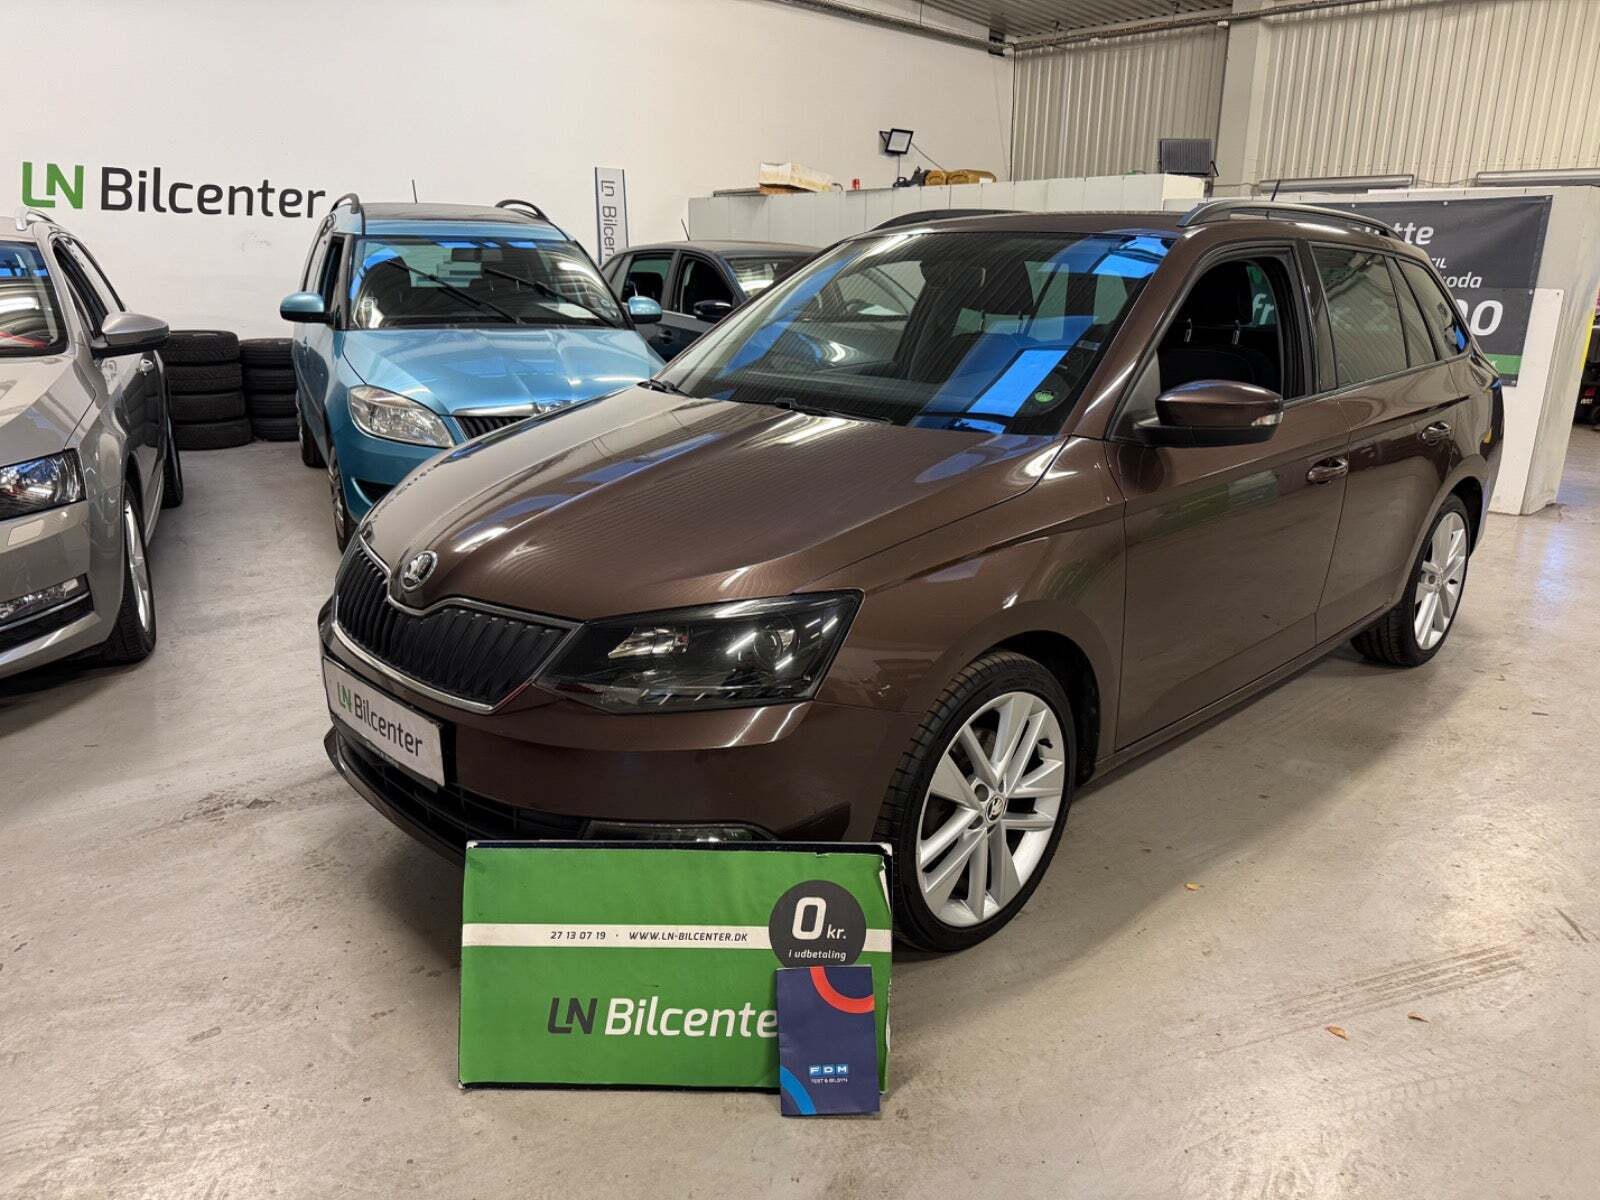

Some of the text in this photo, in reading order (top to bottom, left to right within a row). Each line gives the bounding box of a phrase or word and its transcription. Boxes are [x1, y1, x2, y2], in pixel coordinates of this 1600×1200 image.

[22, 162, 326, 218] LN Bilcenter
[602, 206, 617, 256] Bilcen
[337, 682, 423, 757] LN Bilcenter
[550, 931, 748, 942] 27 13 07 19 WWW.LN-BILCENTER.DK
[792, 897, 847, 940] 0 kr.
[794, 949, 847, 962] udbetaling
[547, 996, 778, 1038] LN Bilcente
